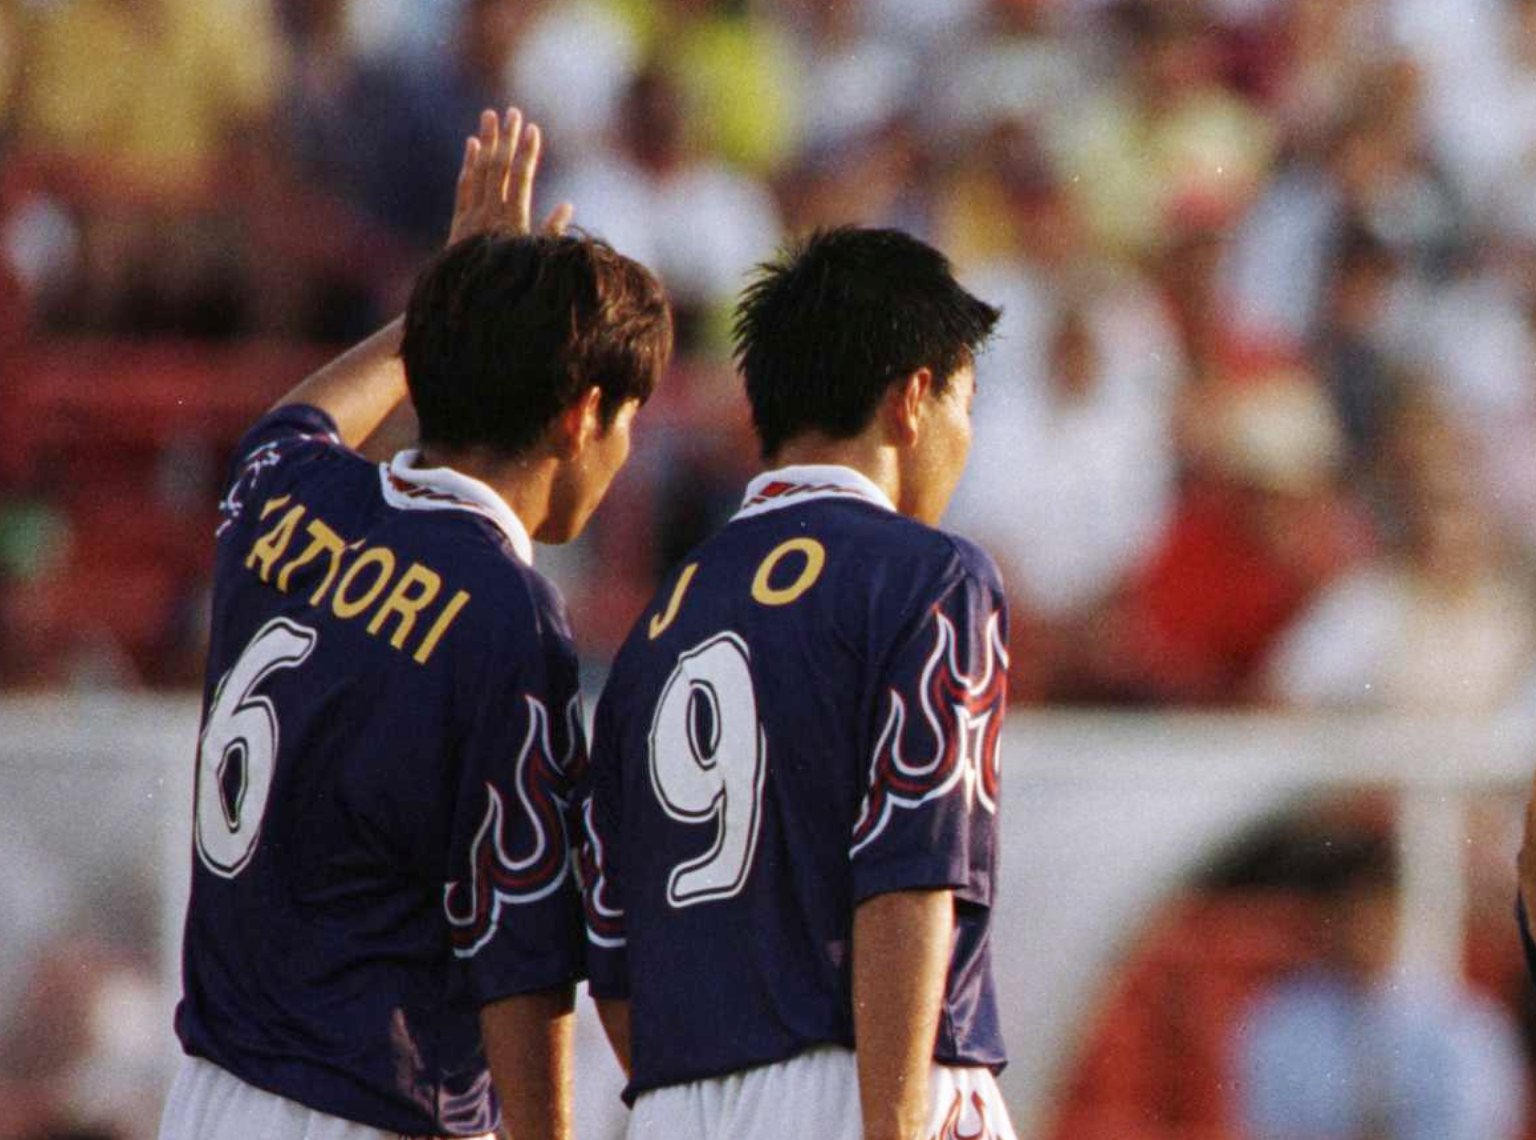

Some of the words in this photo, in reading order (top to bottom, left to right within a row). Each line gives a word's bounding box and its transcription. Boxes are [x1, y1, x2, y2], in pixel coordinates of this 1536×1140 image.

[245, 494, 472, 666] ATTORI
[194, 616, 318, 878] 6
[648, 630, 768, 910] 9
